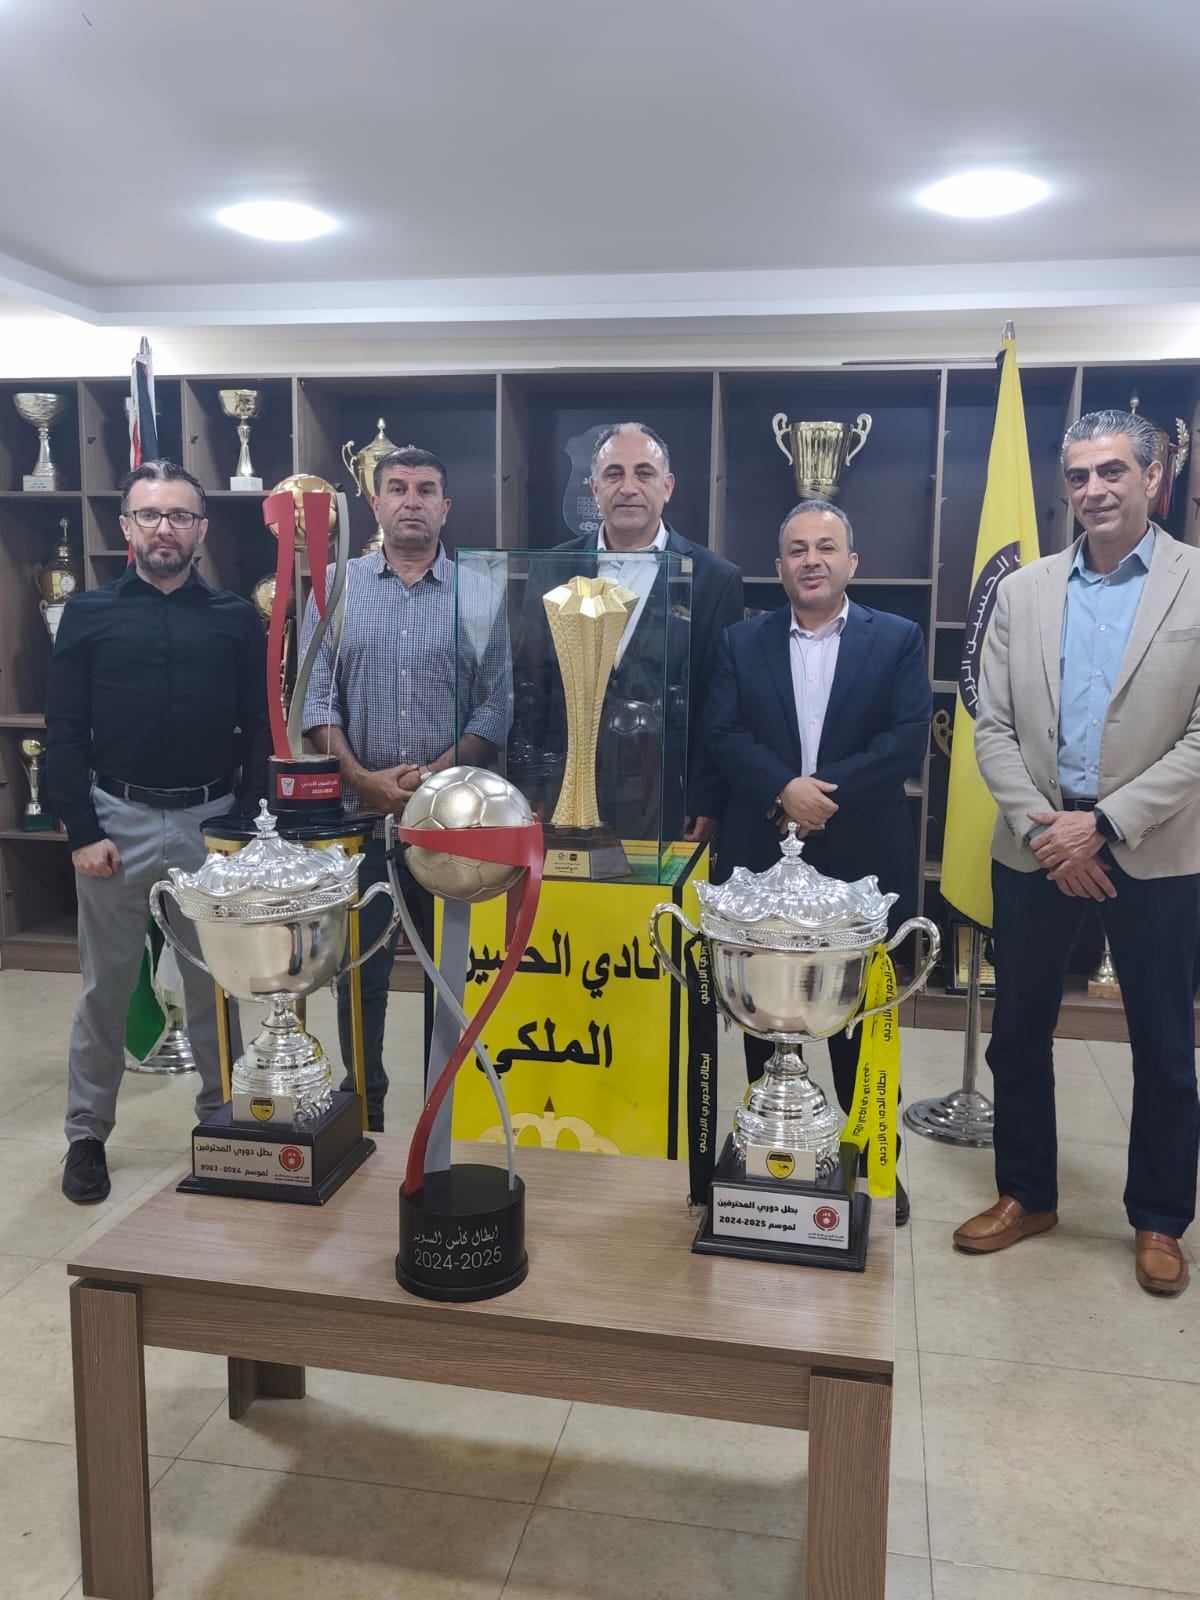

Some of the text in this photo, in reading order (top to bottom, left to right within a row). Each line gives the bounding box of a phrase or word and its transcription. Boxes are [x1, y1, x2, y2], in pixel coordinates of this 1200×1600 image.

[965, 554, 1009, 655] الحسين
[475, 1017, 613, 1079] الملكي
[700, 1081, 711, 1116] الدوري
[196, 1143, 273, 1157] بطل دوري المحترفين
[201, 1164, 219, 1172] 2023
[224, 1166, 242, 1174] 2024
[244, 1169, 268, 1178] لموسم
[717, 1198, 798, 1214] بطل دوري المحترفين
[719, 1215, 796, 1231] لموسم 2024-2025
[446, 1226, 467, 1249] كأس
[472, 1225, 499, 1245] ابطال
[413, 1245, 503, 1270] 2024-2025
